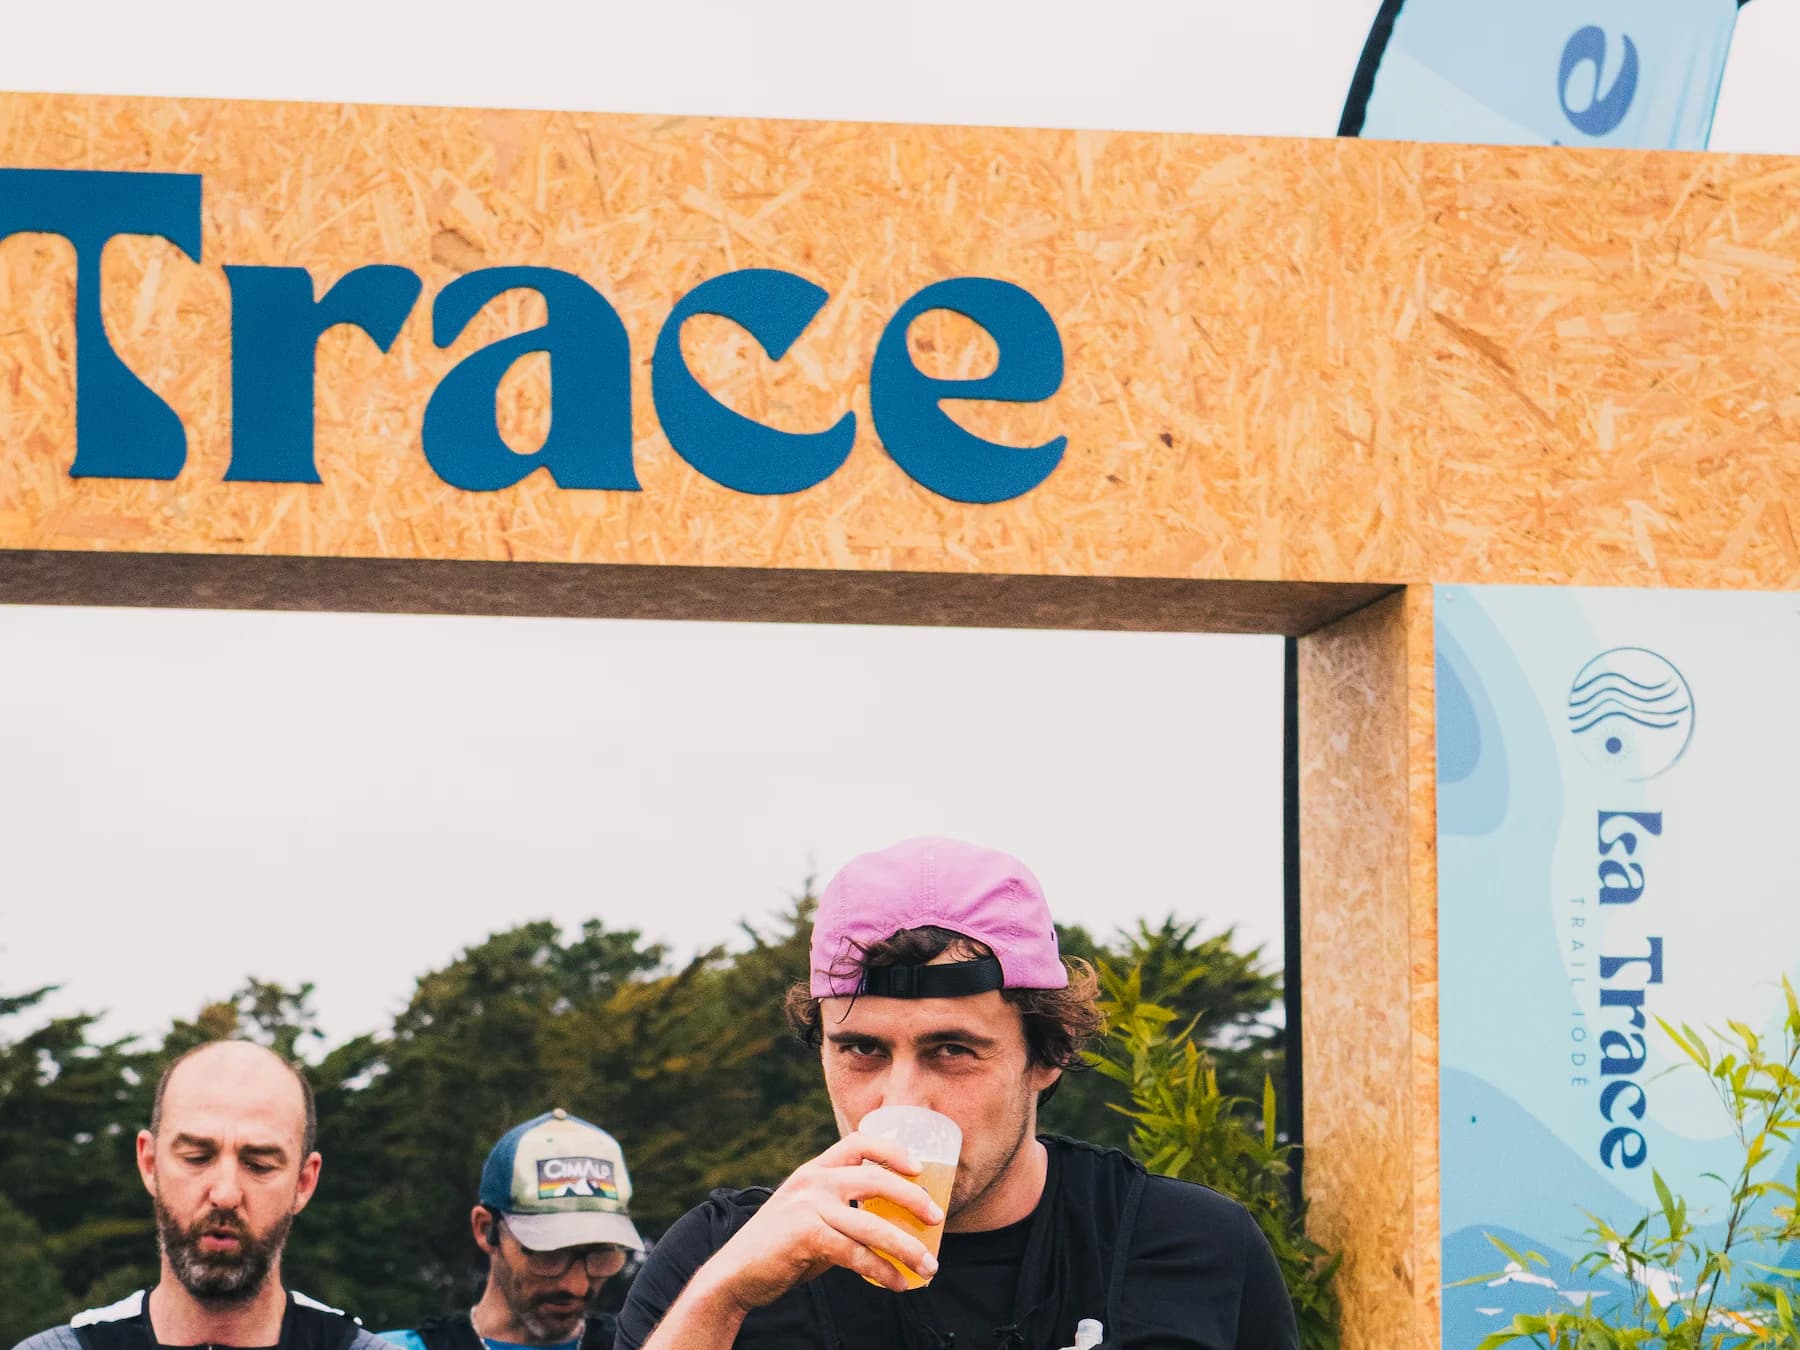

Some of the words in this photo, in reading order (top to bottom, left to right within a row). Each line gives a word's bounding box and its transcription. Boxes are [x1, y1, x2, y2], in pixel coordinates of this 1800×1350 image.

[0, 168, 1068, 504] Trace
[1598, 809, 1663, 906] La
[1568, 897, 1585, 985] TRAIL
[1599, 936, 1664, 1171] Trace
